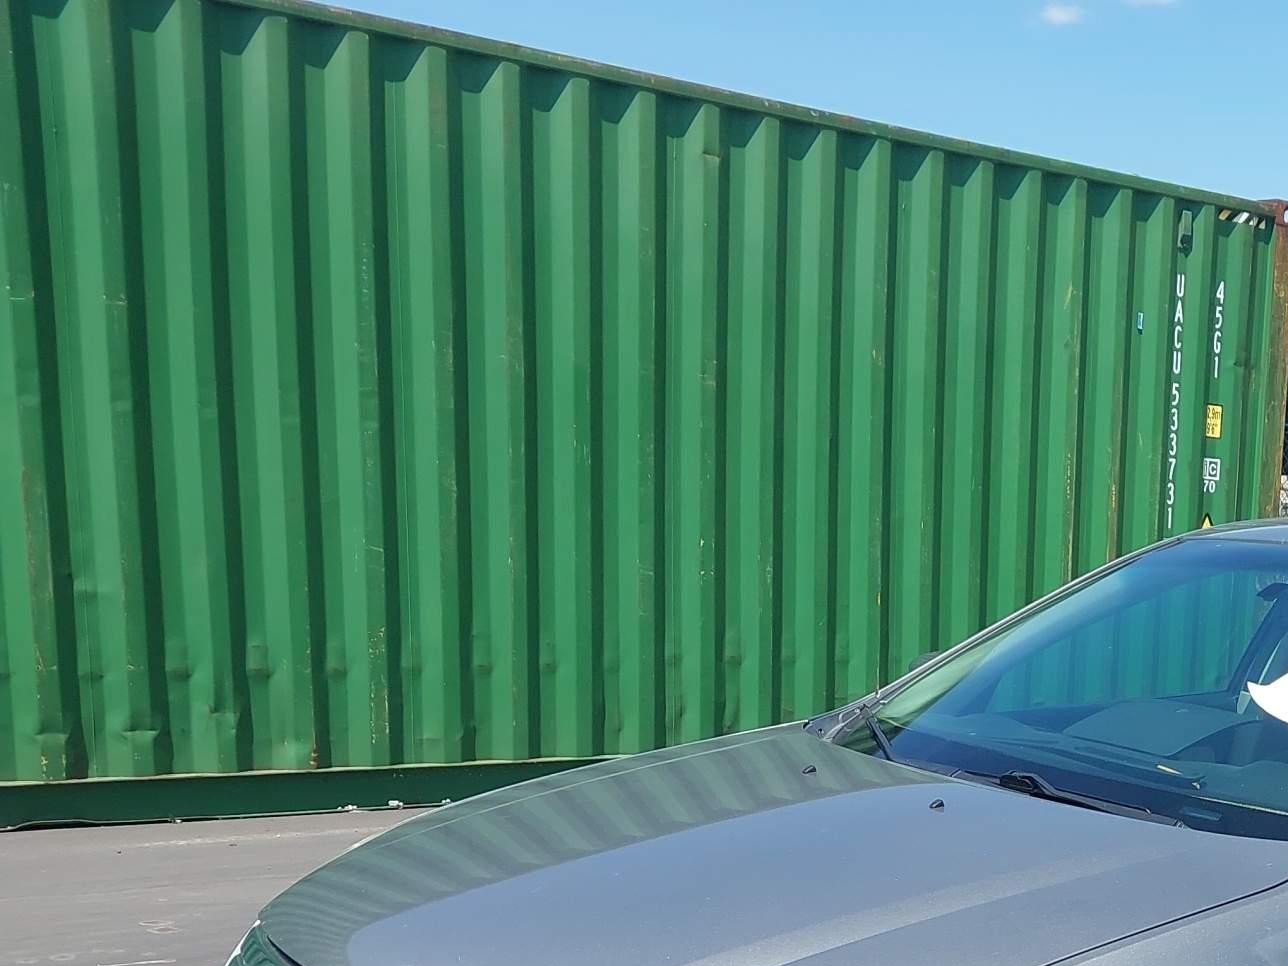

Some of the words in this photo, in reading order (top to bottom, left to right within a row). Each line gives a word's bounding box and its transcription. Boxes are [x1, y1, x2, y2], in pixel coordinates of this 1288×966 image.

[1173, 273, 1185, 375] UACU
[1213, 280, 1225, 379] 45G1
[1166, 383, 1180, 529] 533731
[1203, 480, 1216, 494] 70
